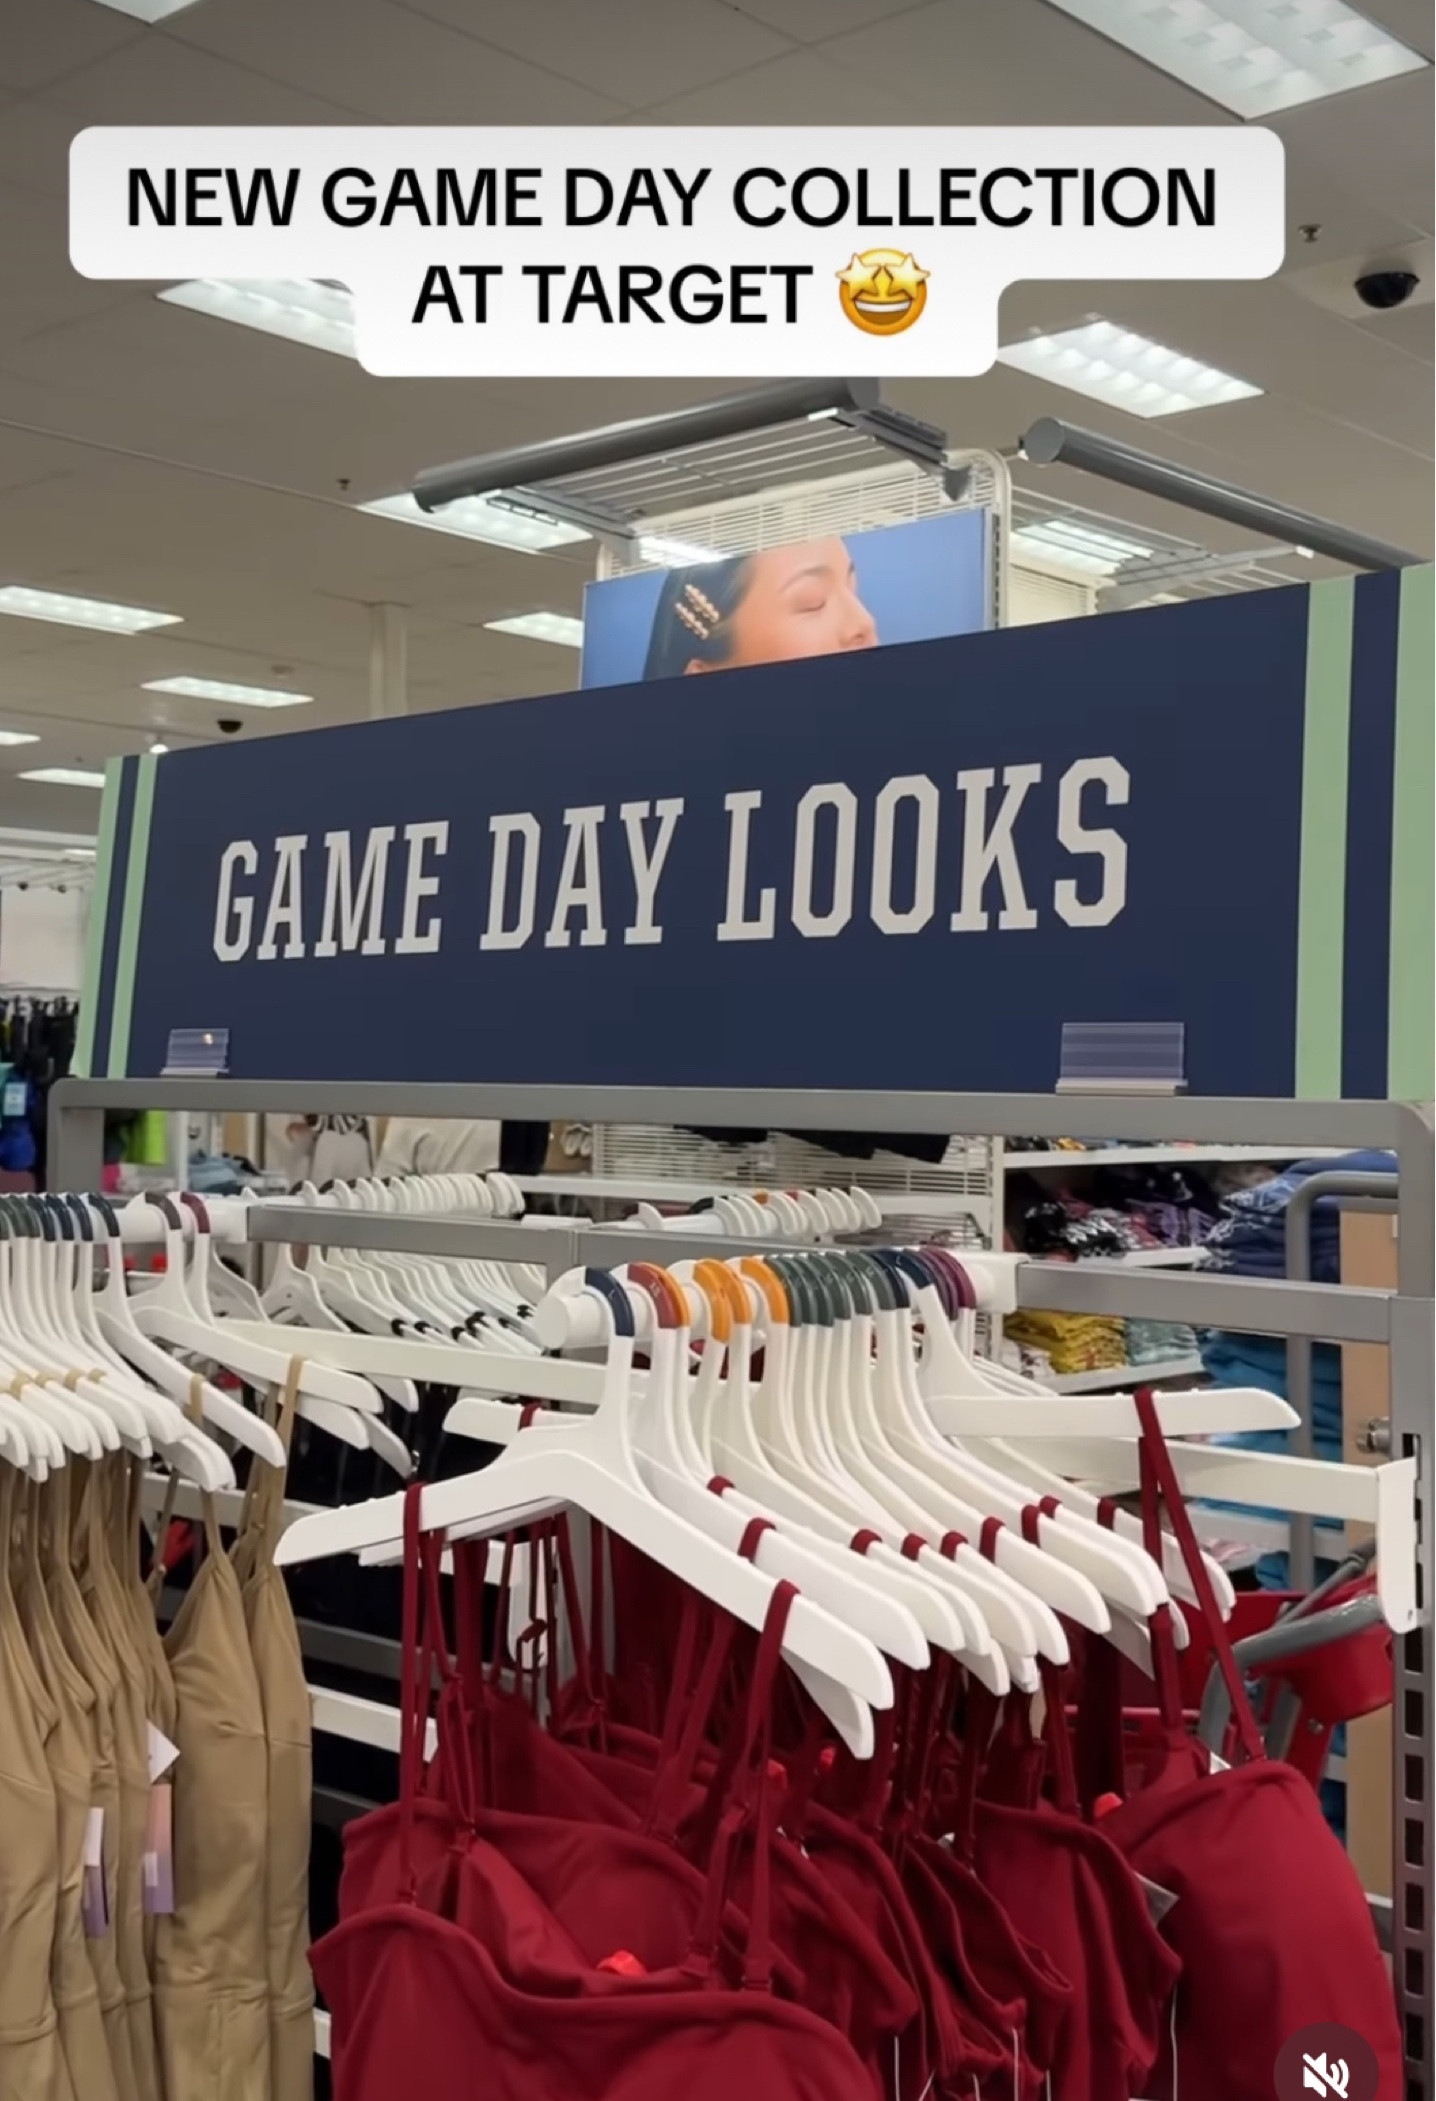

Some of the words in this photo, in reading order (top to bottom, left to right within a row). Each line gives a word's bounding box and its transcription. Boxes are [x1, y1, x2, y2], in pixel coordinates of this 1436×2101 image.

[213, 820, 449, 962] GAME
[479, 797, 684, 950] DAY
[717, 756, 1130, 941] LOOKS
